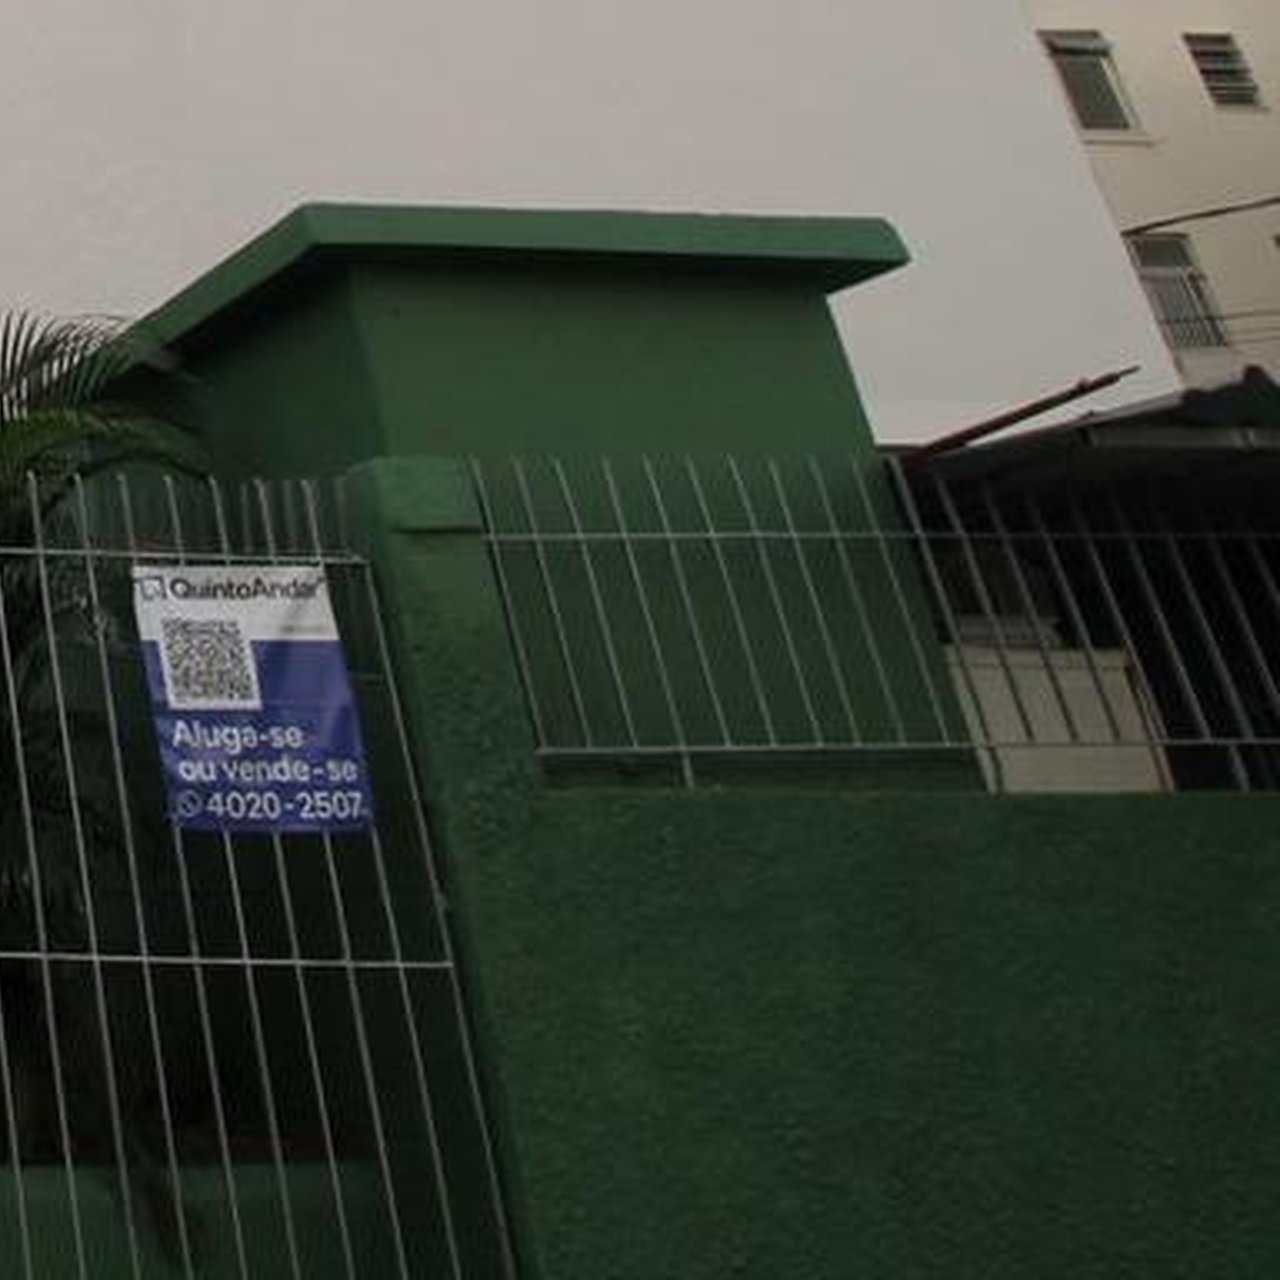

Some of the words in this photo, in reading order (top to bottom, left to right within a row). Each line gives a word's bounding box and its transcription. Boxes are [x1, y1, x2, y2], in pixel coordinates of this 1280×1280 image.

[169, 577, 320, 601] QuintoAndar
[172, 720, 305, 756] Aluga-se
[178, 761, 217, 782] ou
[221, 756, 359, 783] vende-se
[206, 791, 363, 819] 4020-2507
